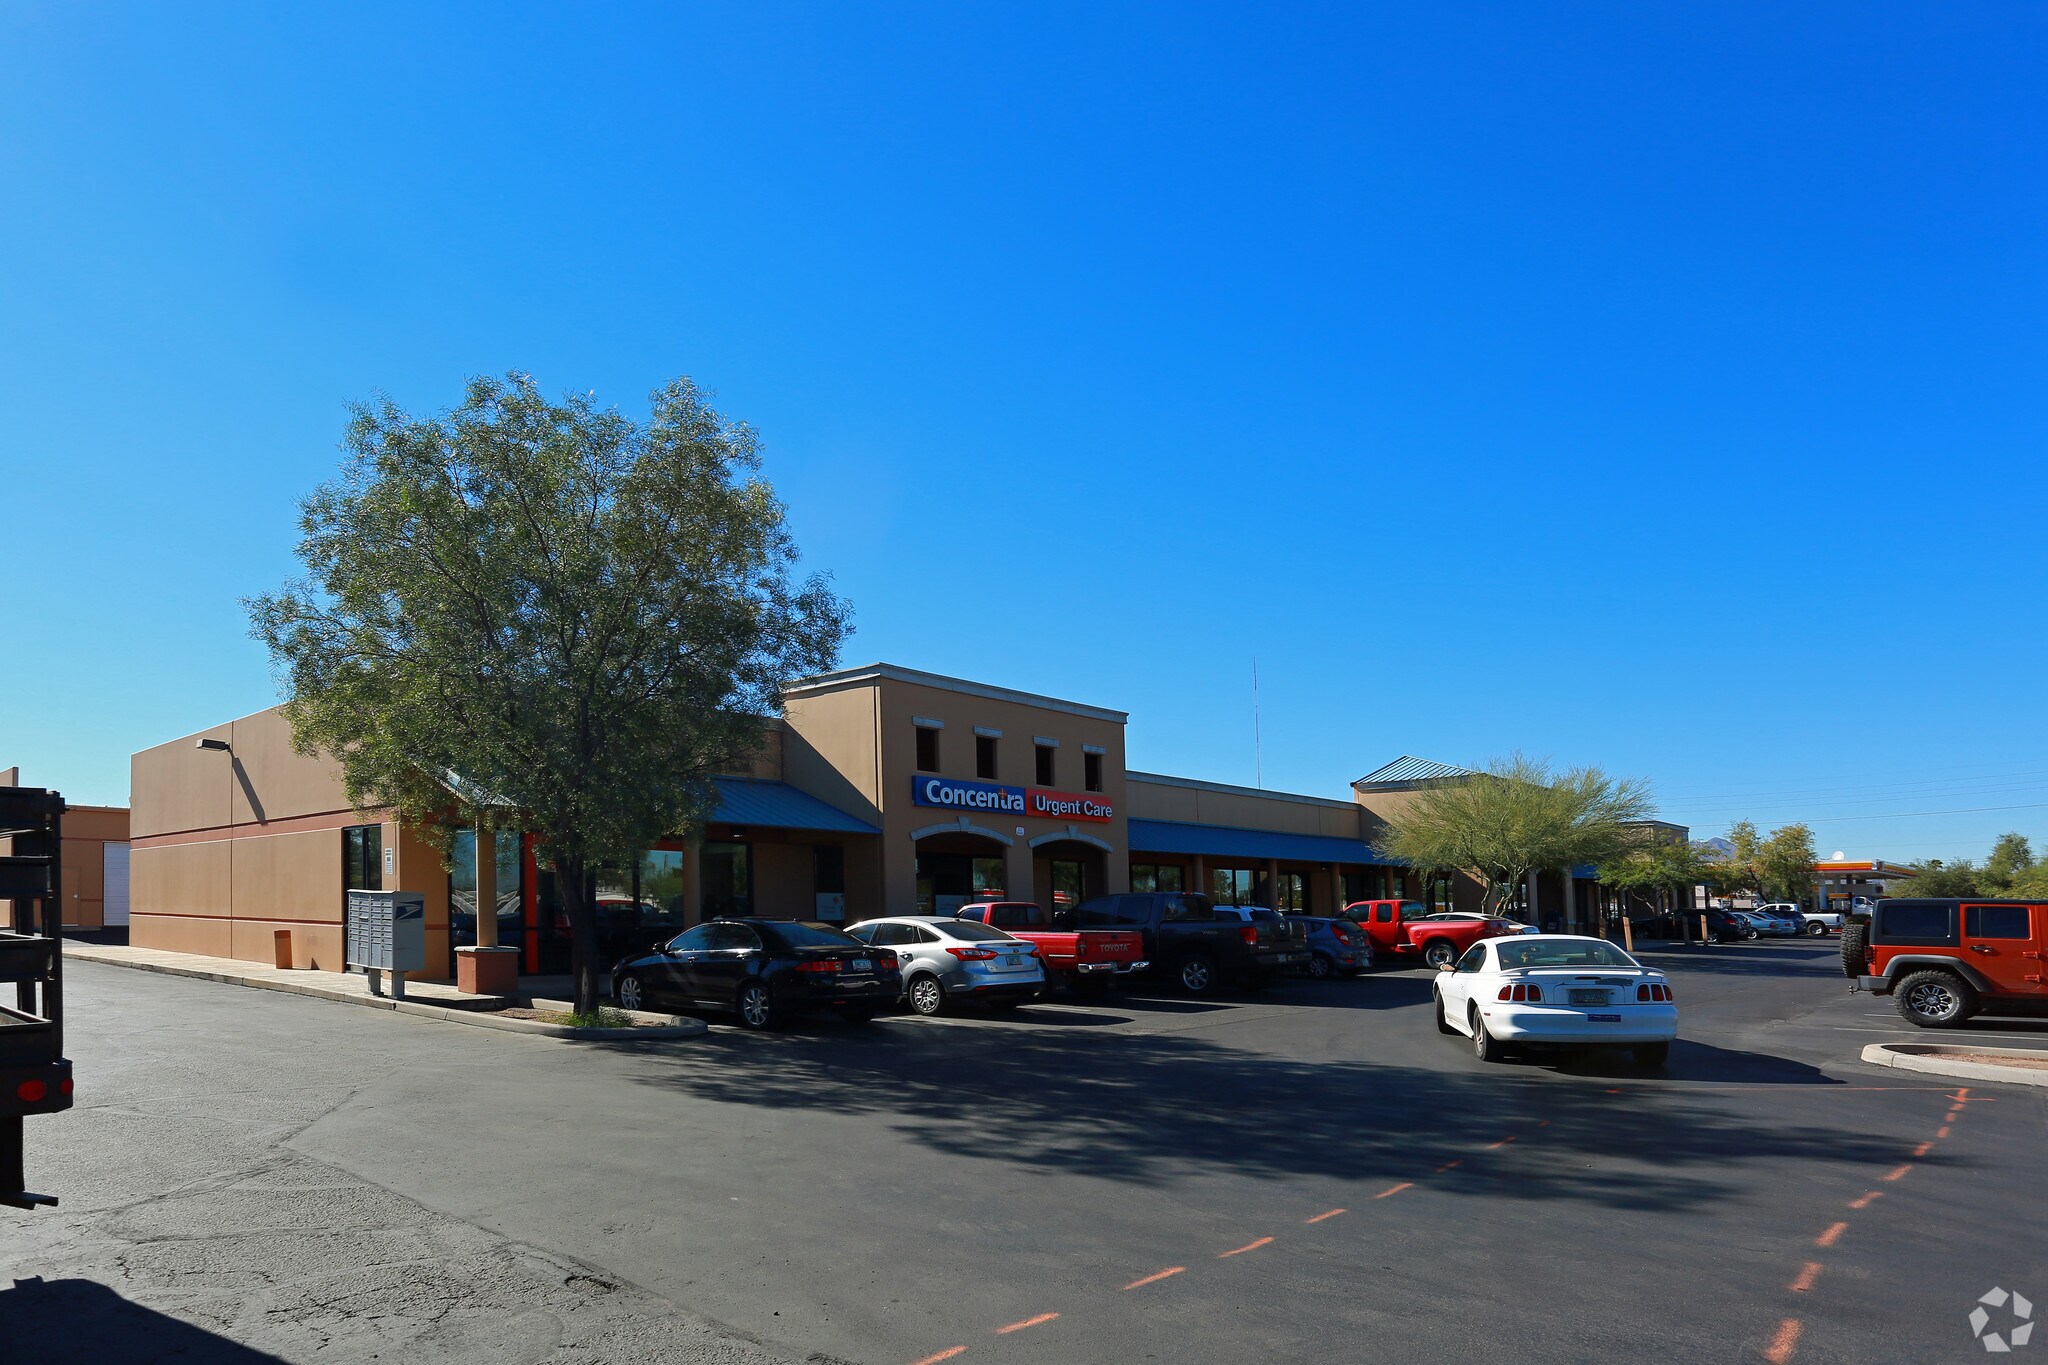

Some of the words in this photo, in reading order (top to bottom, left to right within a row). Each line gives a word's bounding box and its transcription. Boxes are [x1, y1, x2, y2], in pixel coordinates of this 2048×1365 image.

[926, 780, 1024, 811] Concentra
[1036, 795, 1081, 816] Urgent
[1083, 800, 1113, 818] Care
[1100, 944, 1129, 952] TOYOTA
